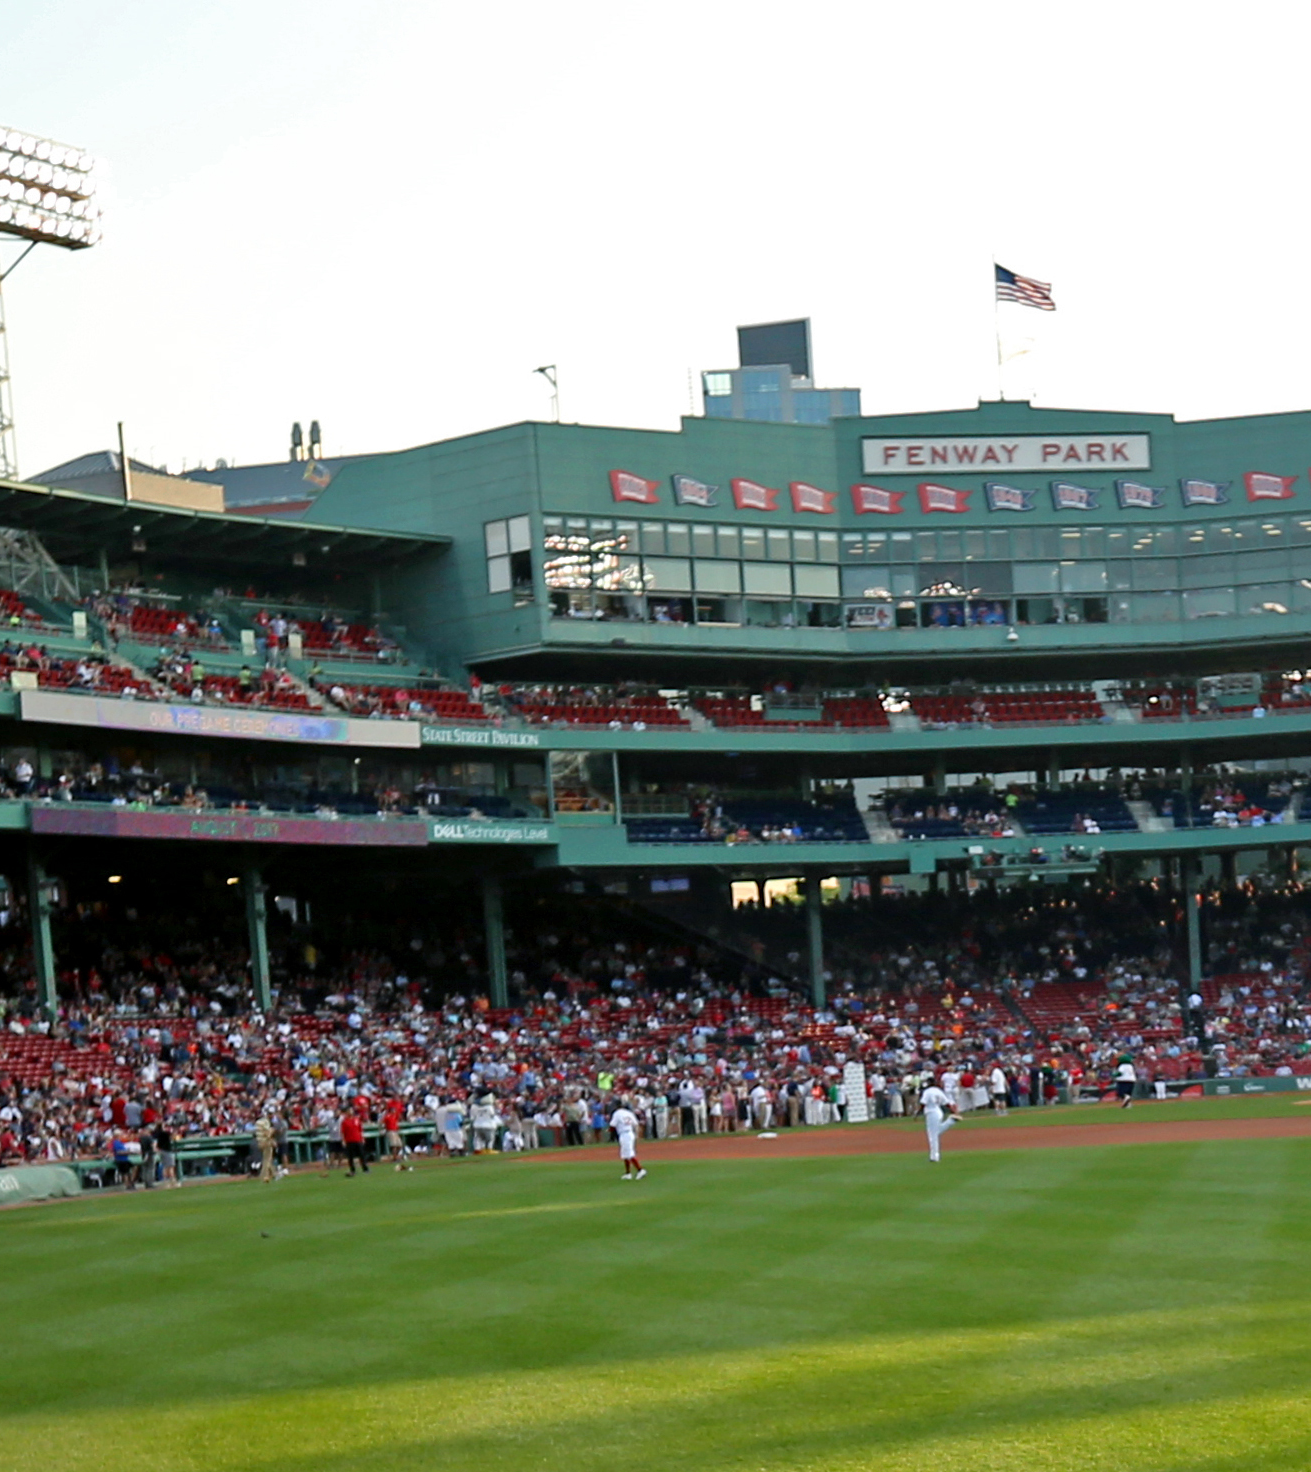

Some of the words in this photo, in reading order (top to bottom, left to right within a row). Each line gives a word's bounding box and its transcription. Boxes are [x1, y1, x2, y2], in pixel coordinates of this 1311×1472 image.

[882, 444, 1020, 465] FENWAY
[1041, 442, 1130, 464] PARK
[433, 824, 464, 838] DELL
[463, 824, 523, 842] Technologies
[524, 826, 548, 840] Level
